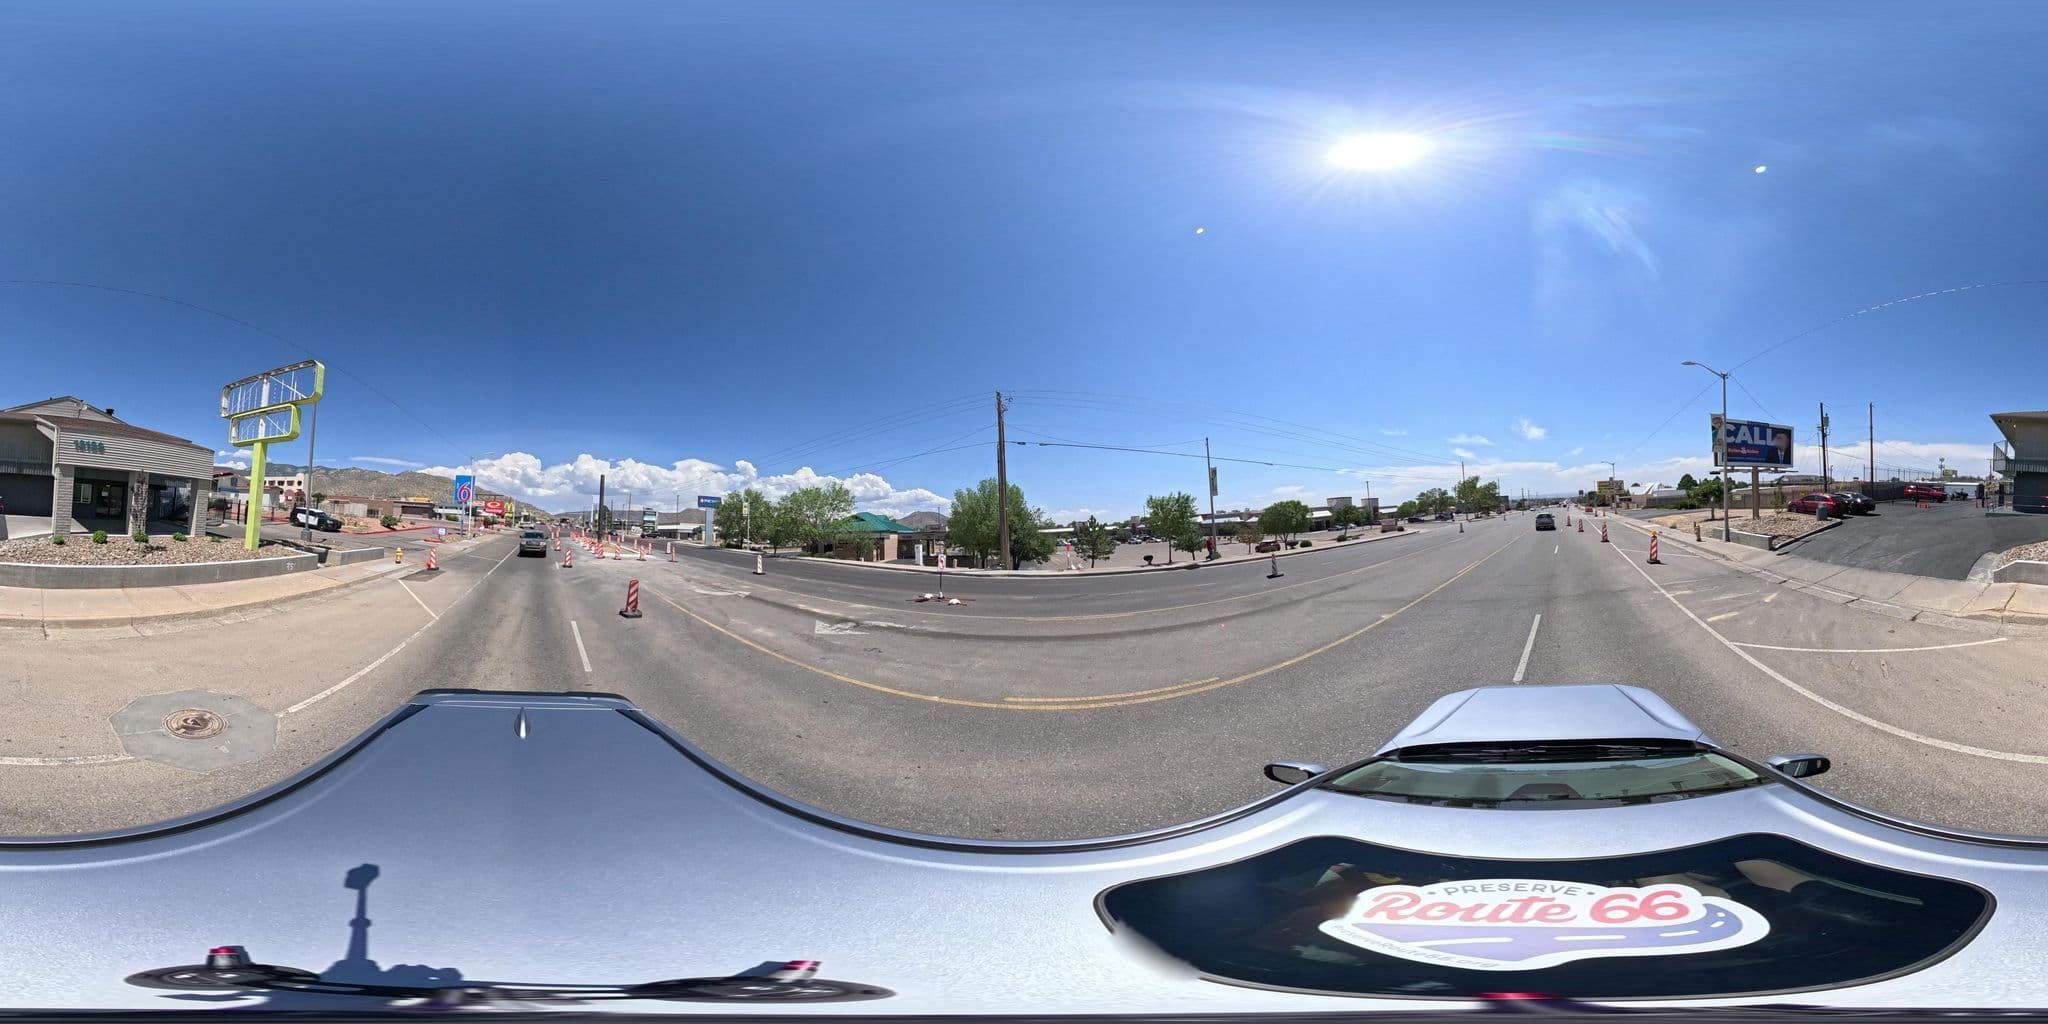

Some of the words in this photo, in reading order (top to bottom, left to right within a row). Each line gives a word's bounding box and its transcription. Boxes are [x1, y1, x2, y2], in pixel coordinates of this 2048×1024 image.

[1725, 423, 1777, 446] CALL
[458, 482, 472, 502] 6
[1443, 882, 1583, 896] PRESERVE
[1362, 890, 1578, 923] Route
[1590, 890, 1690, 924] 66
